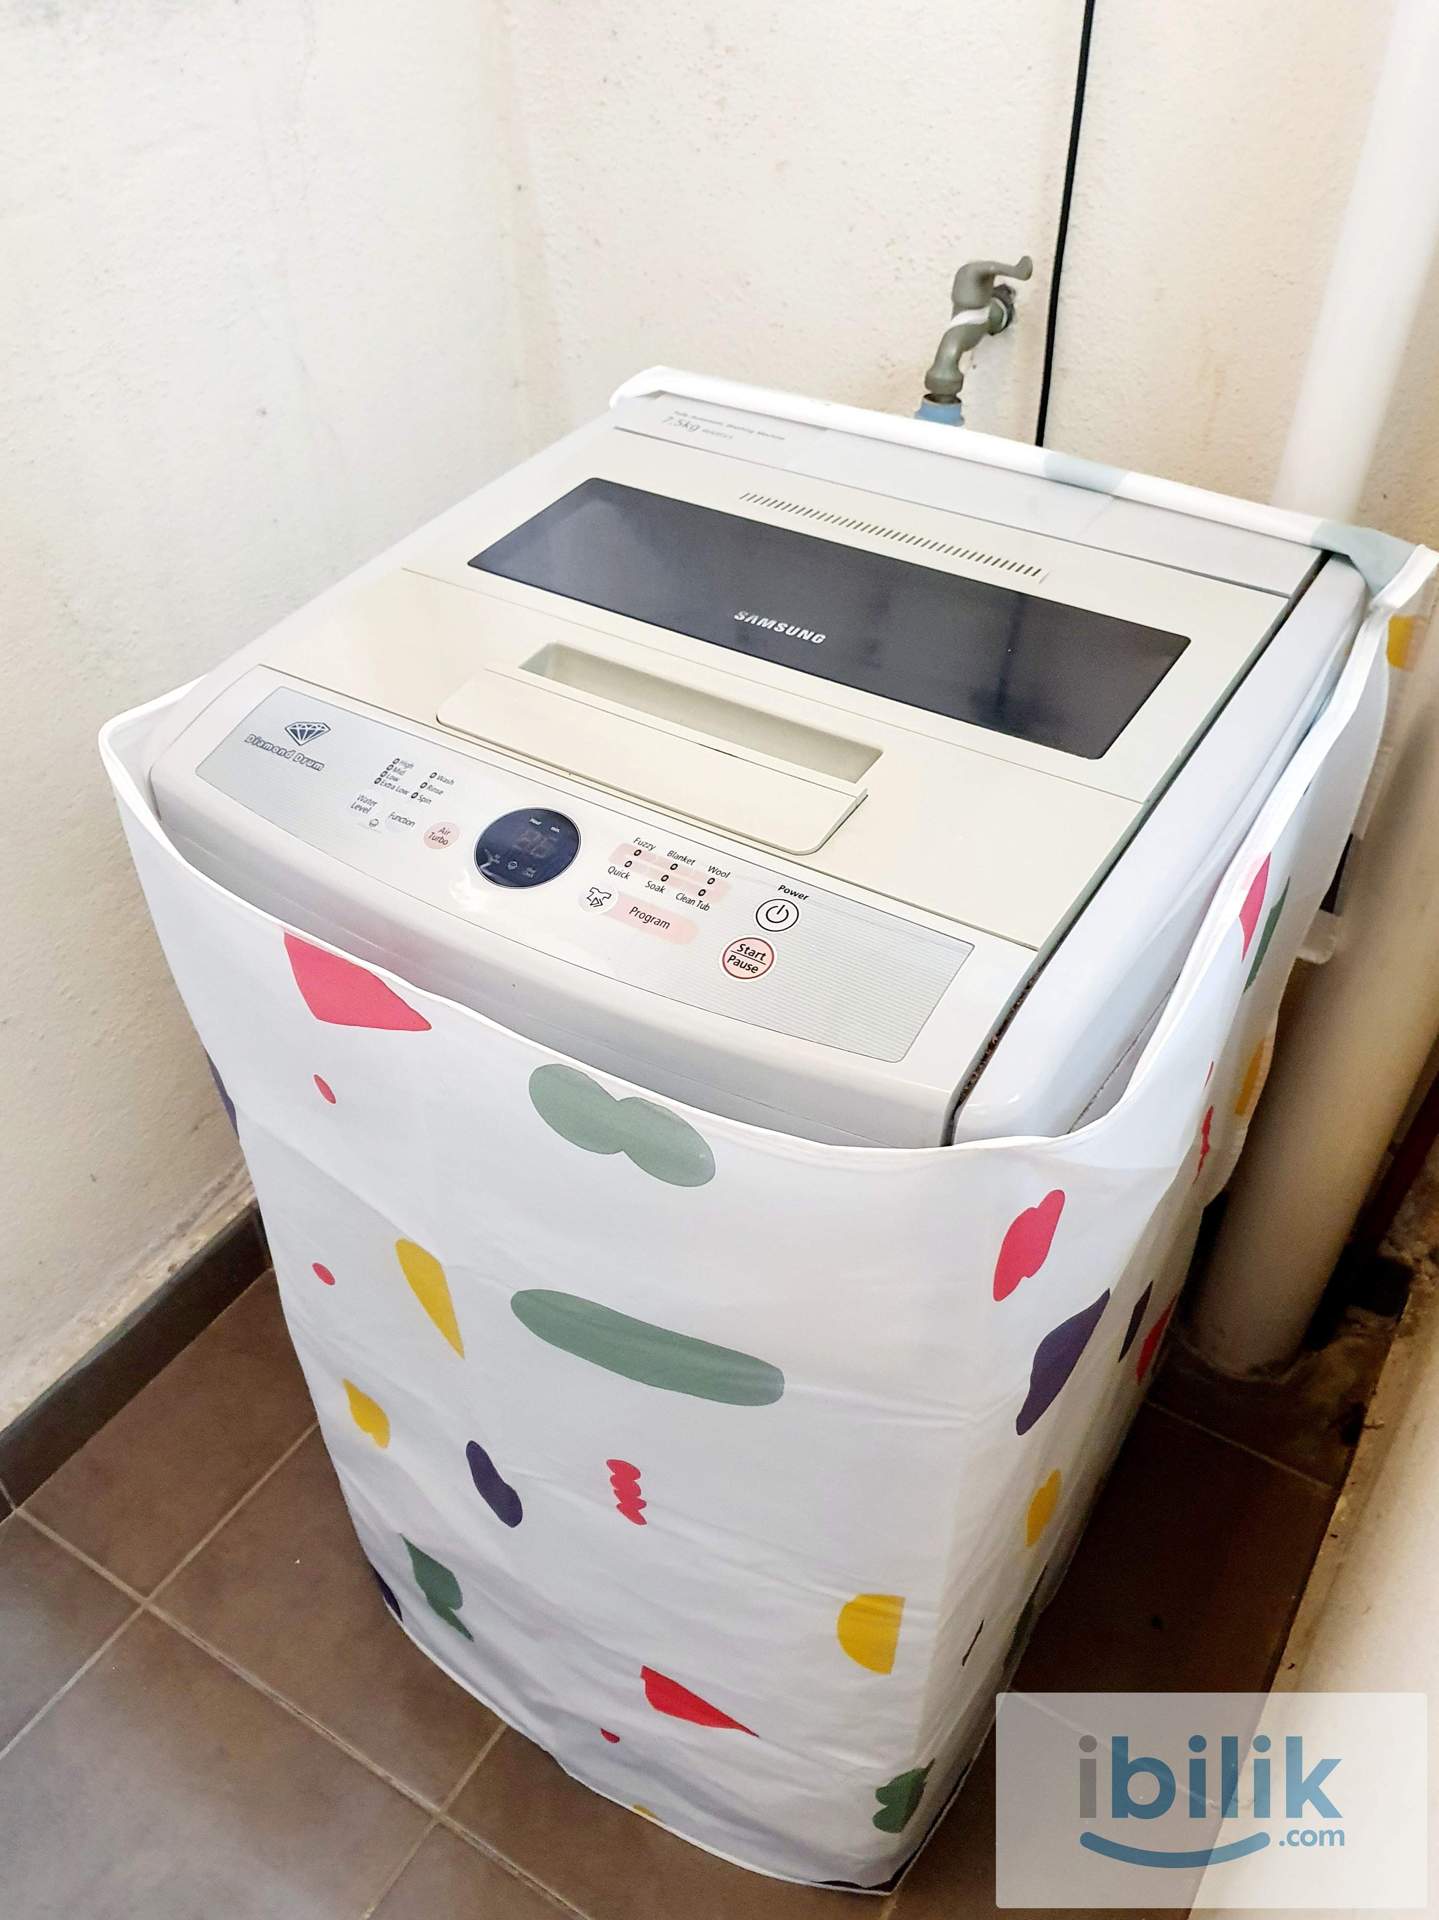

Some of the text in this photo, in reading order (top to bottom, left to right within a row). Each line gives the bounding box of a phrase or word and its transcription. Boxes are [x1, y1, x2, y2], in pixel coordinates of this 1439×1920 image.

[733, 610, 827, 644] SAMSUNG
[244, 733, 325, 771] Diamond Drum
[380, 780, 396, 790] Extra
[350, 801, 372, 814] Level
[357, 794, 378, 807] Water
[388, 811, 416, 828] Function
[428, 832, 449, 846] Turbo
[438, 827, 451, 836] Air
[632, 837, 657, 851] Fuzzy
[666, 850, 697, 867] Blanket
[607, 866, 631, 881] Quick
[707, 865, 731, 880] Wool
[644, 880, 666, 894] Soak
[777, 884, 810, 901] Power
[675, 892, 711, 912] Clean Tub
[628, 906, 671, 930] Program
[736, 943, 767, 962] Start
[726, 954, 760, 974] Pause
